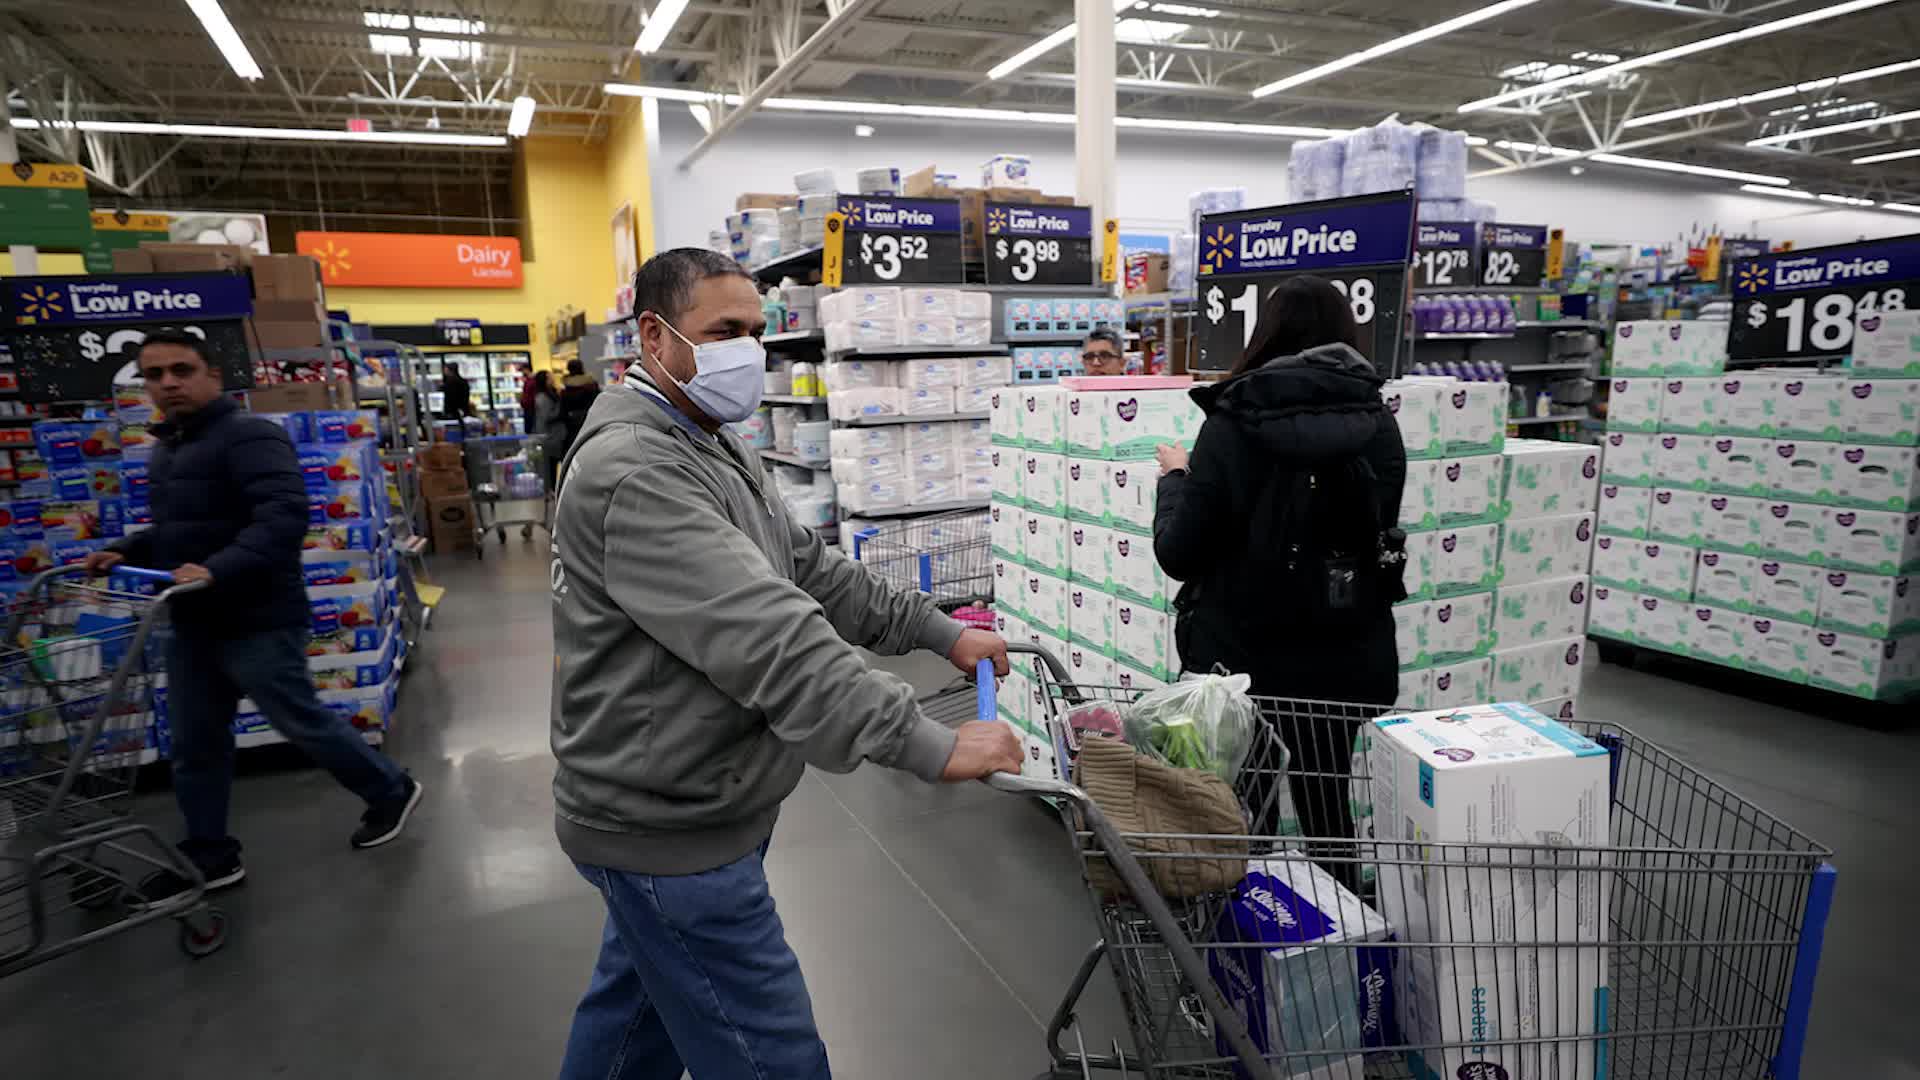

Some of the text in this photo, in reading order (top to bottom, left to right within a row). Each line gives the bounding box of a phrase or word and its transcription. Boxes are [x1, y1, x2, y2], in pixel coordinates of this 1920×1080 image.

[865, 209, 934, 225] Low Price
[1010, 215, 1069, 230] Low Price
[1241, 219, 1282, 234] Everyday
[1240, 224, 1357, 259] Low Price
[457, 243, 511, 267] Dairy
[1775, 257, 1890, 285] Low Price
[68, 283, 119, 294] Everyday
[69, 289, 202, 313] Low Price
